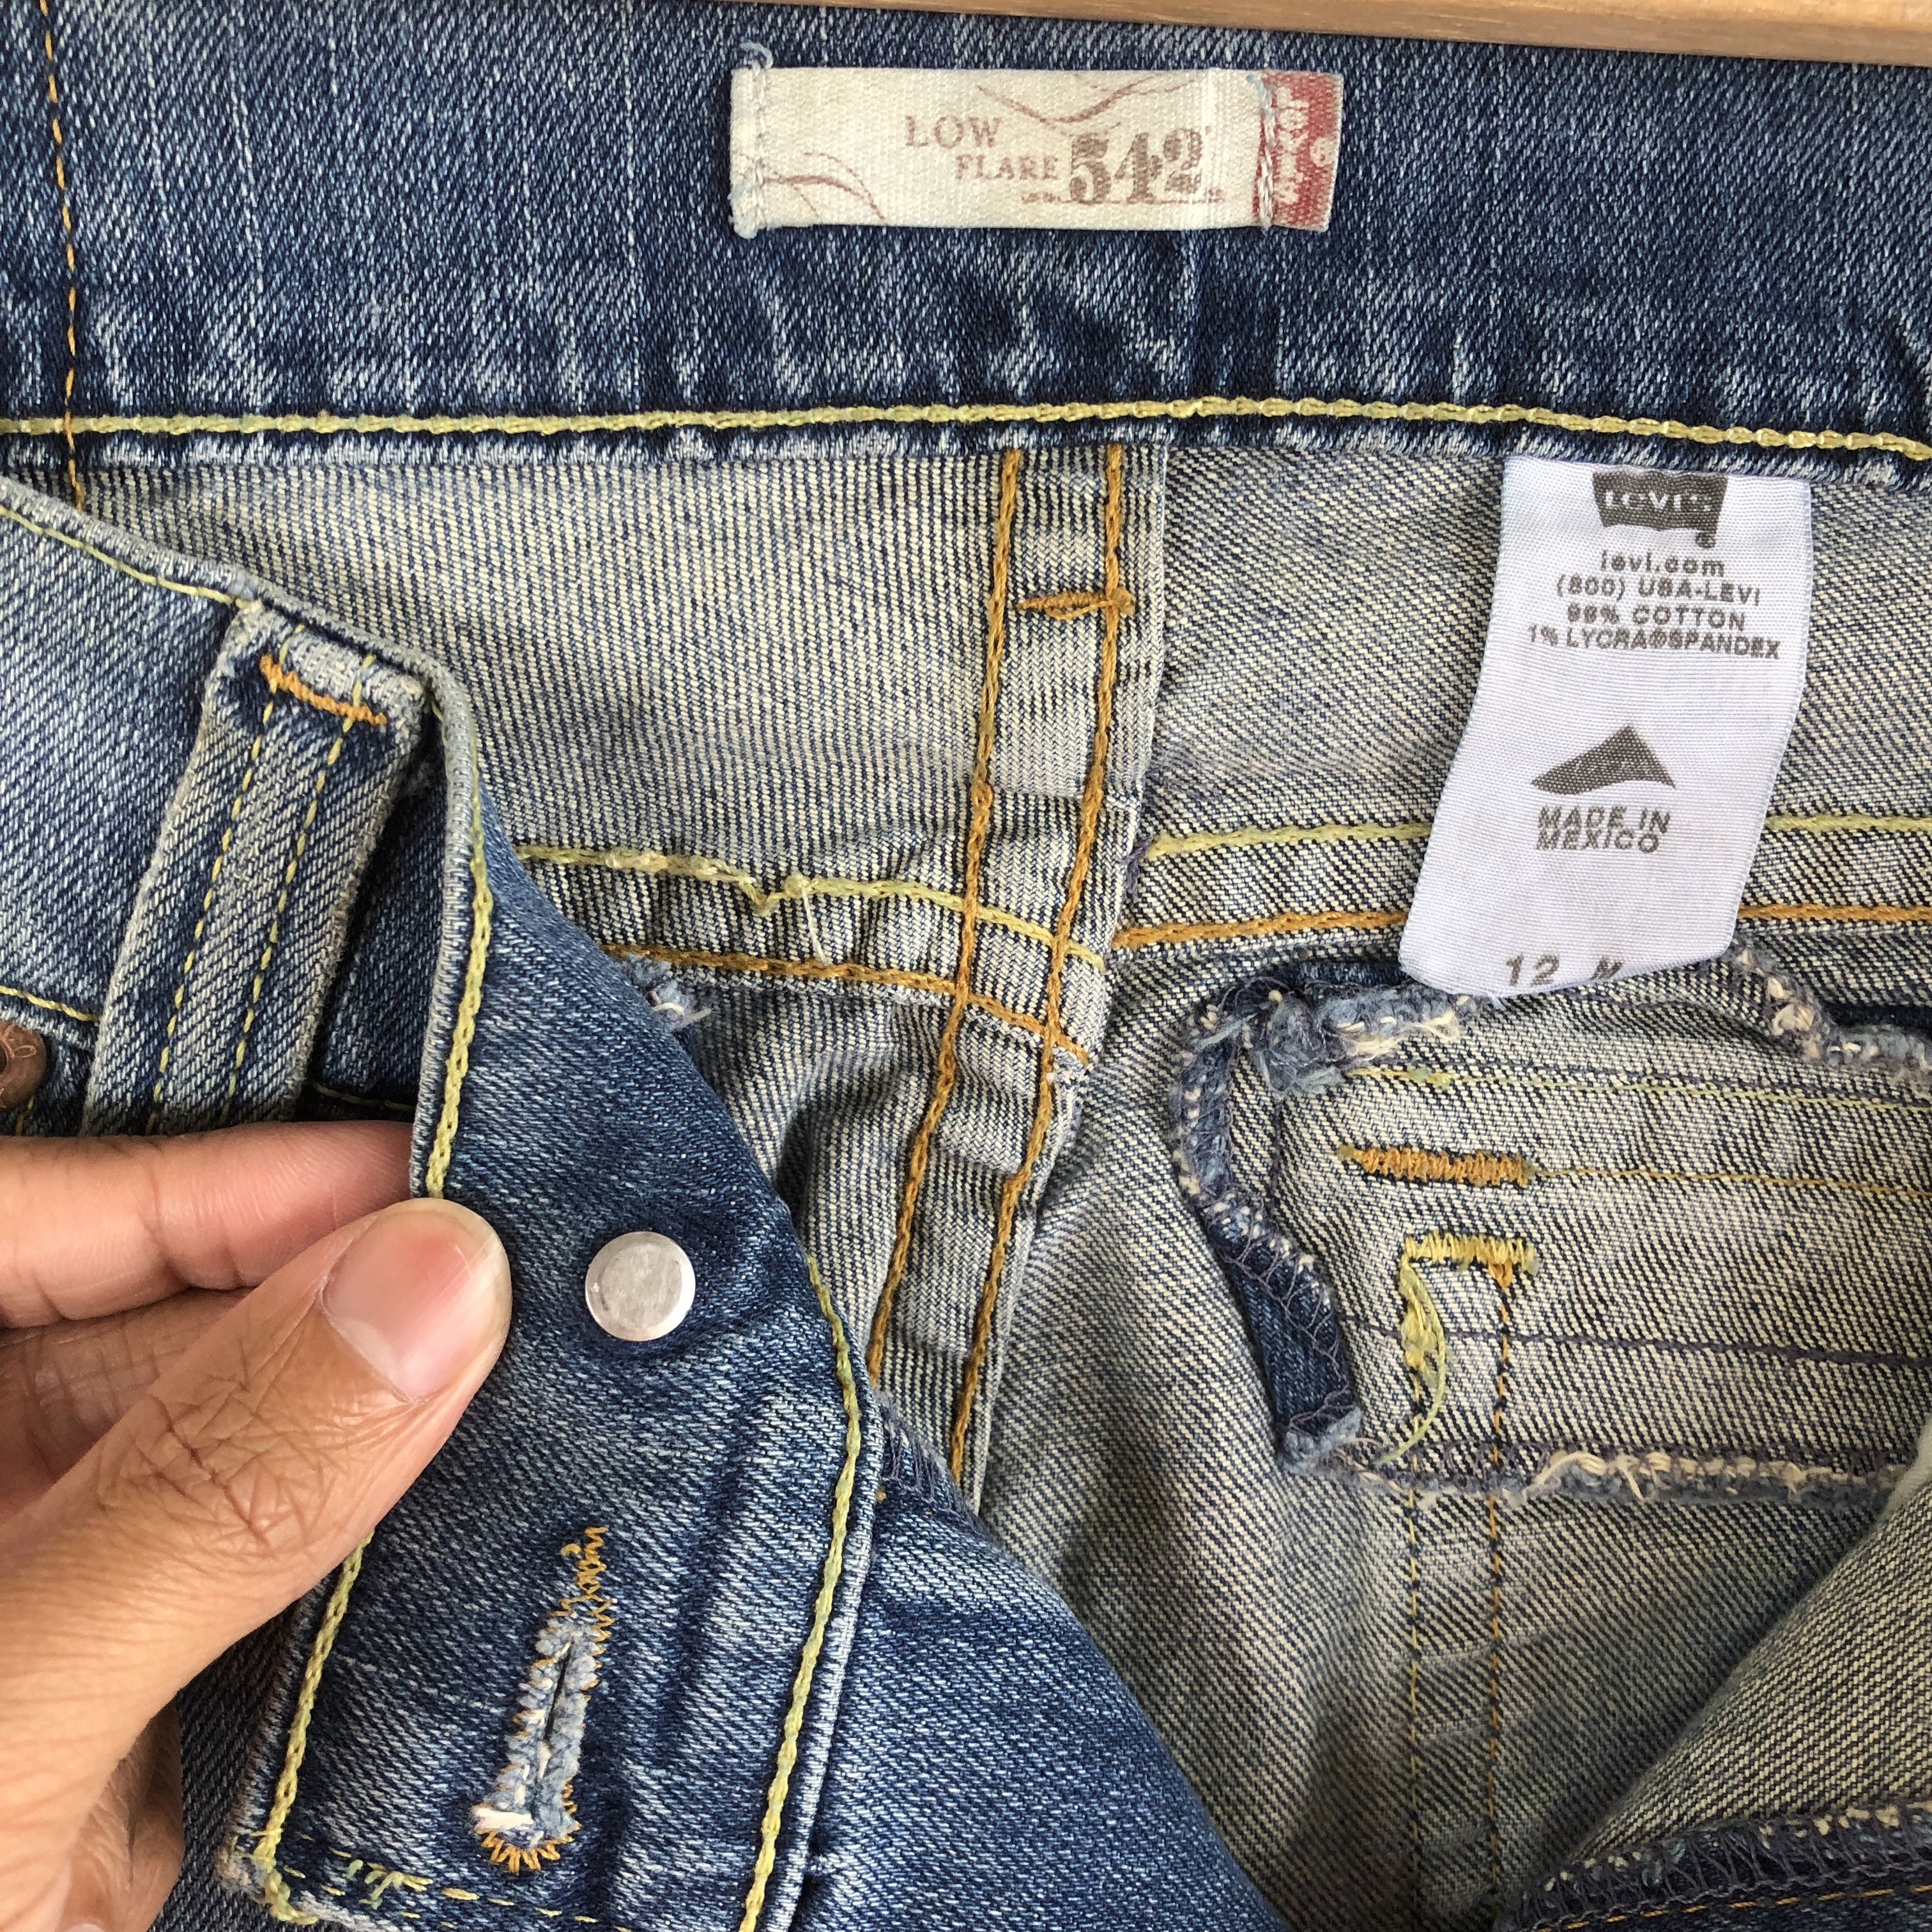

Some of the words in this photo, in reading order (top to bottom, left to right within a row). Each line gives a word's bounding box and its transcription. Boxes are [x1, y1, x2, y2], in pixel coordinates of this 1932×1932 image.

[905, 115, 1002, 150] LOW
[955, 154, 1059, 180] FLARE
[1070, 128, 1202, 204] 542
[1557, 574, 1625, 602] (800)
[1632, 604, 1745, 631] COTTON
[1529, 624, 1559, 647] 1%
[1537, 804, 1628, 829] MADE
[1639, 807, 1671, 834] IN
[1536, 828, 1659, 854] MEXICO
[1506, 954, 1560, 987] 12
